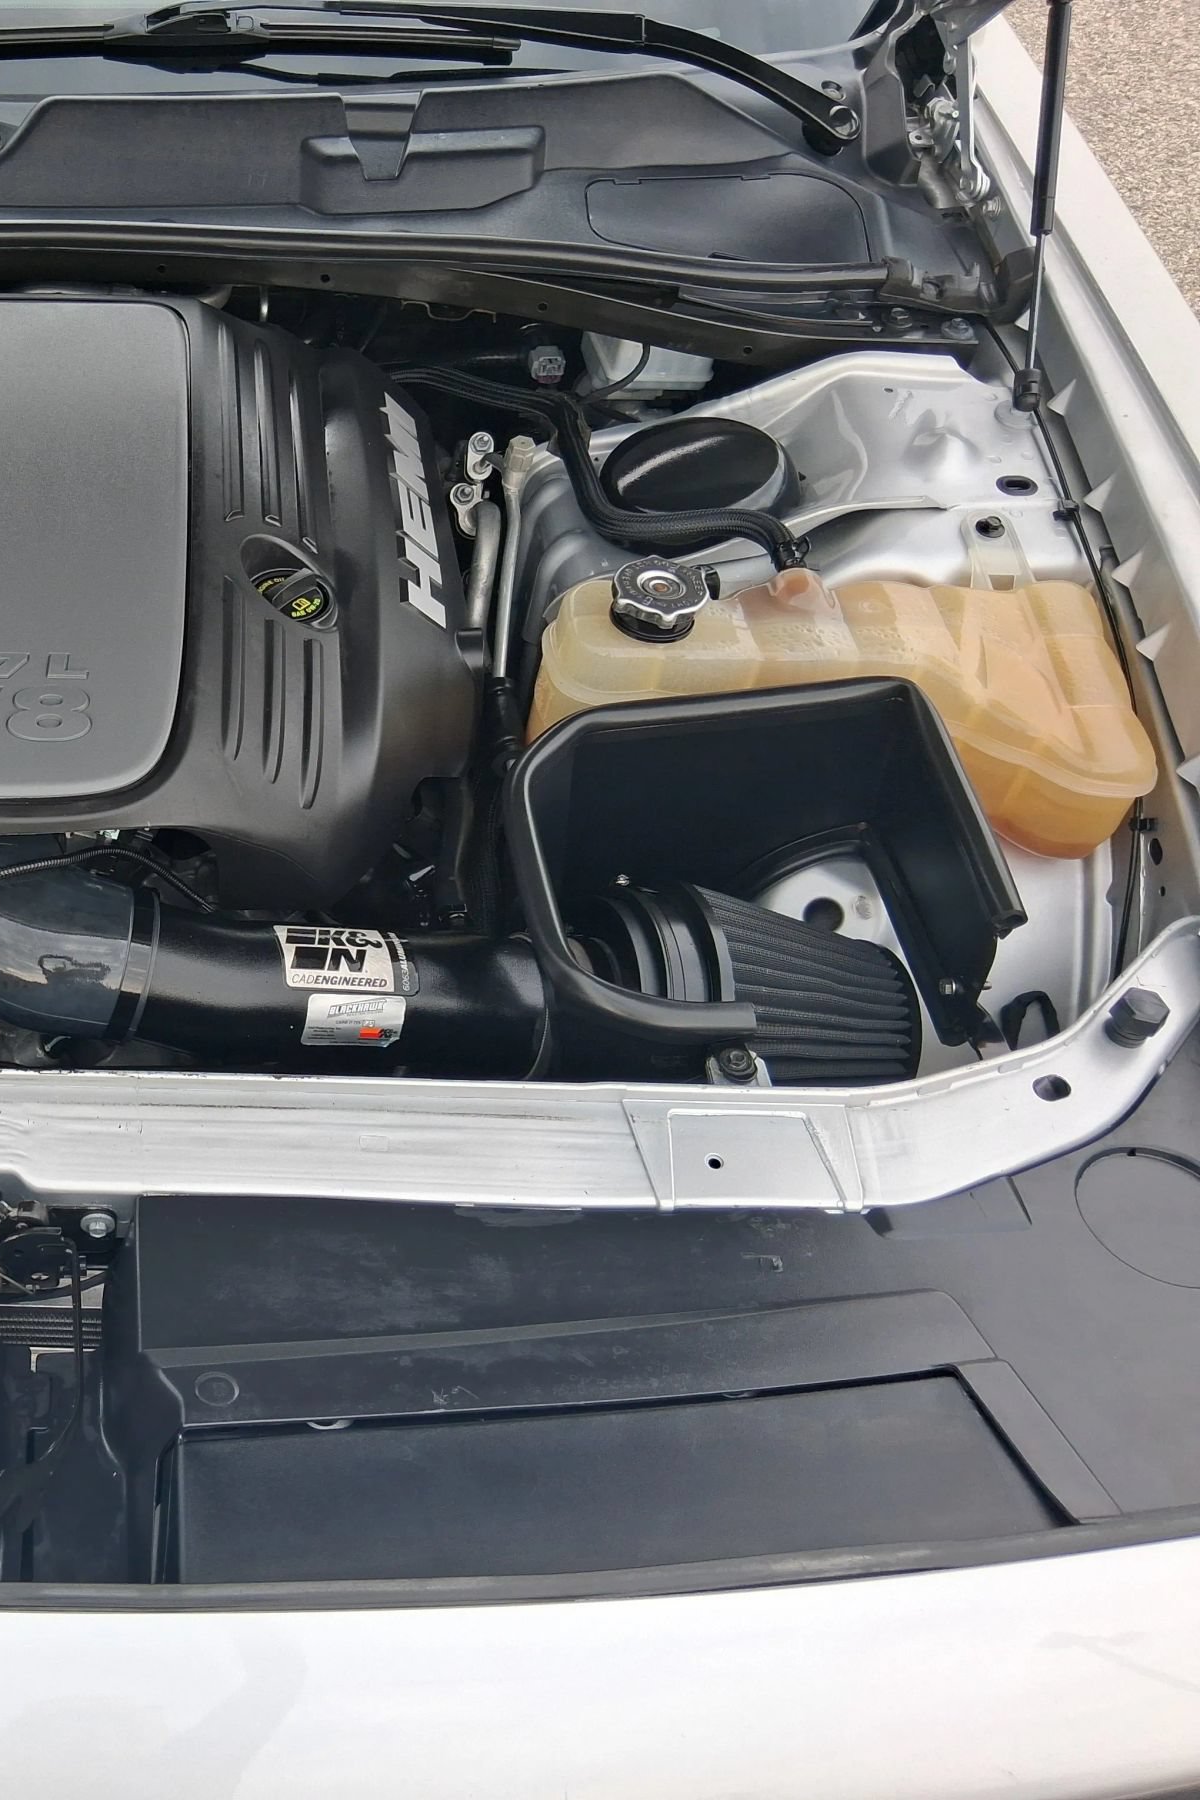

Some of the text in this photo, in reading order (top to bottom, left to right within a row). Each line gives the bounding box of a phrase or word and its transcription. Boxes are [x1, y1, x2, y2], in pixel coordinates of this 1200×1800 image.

[384, 392, 447, 629] HEMI
[46, 652, 90, 680] L
[329, 1001, 385, 1015] BLACKHAWK
